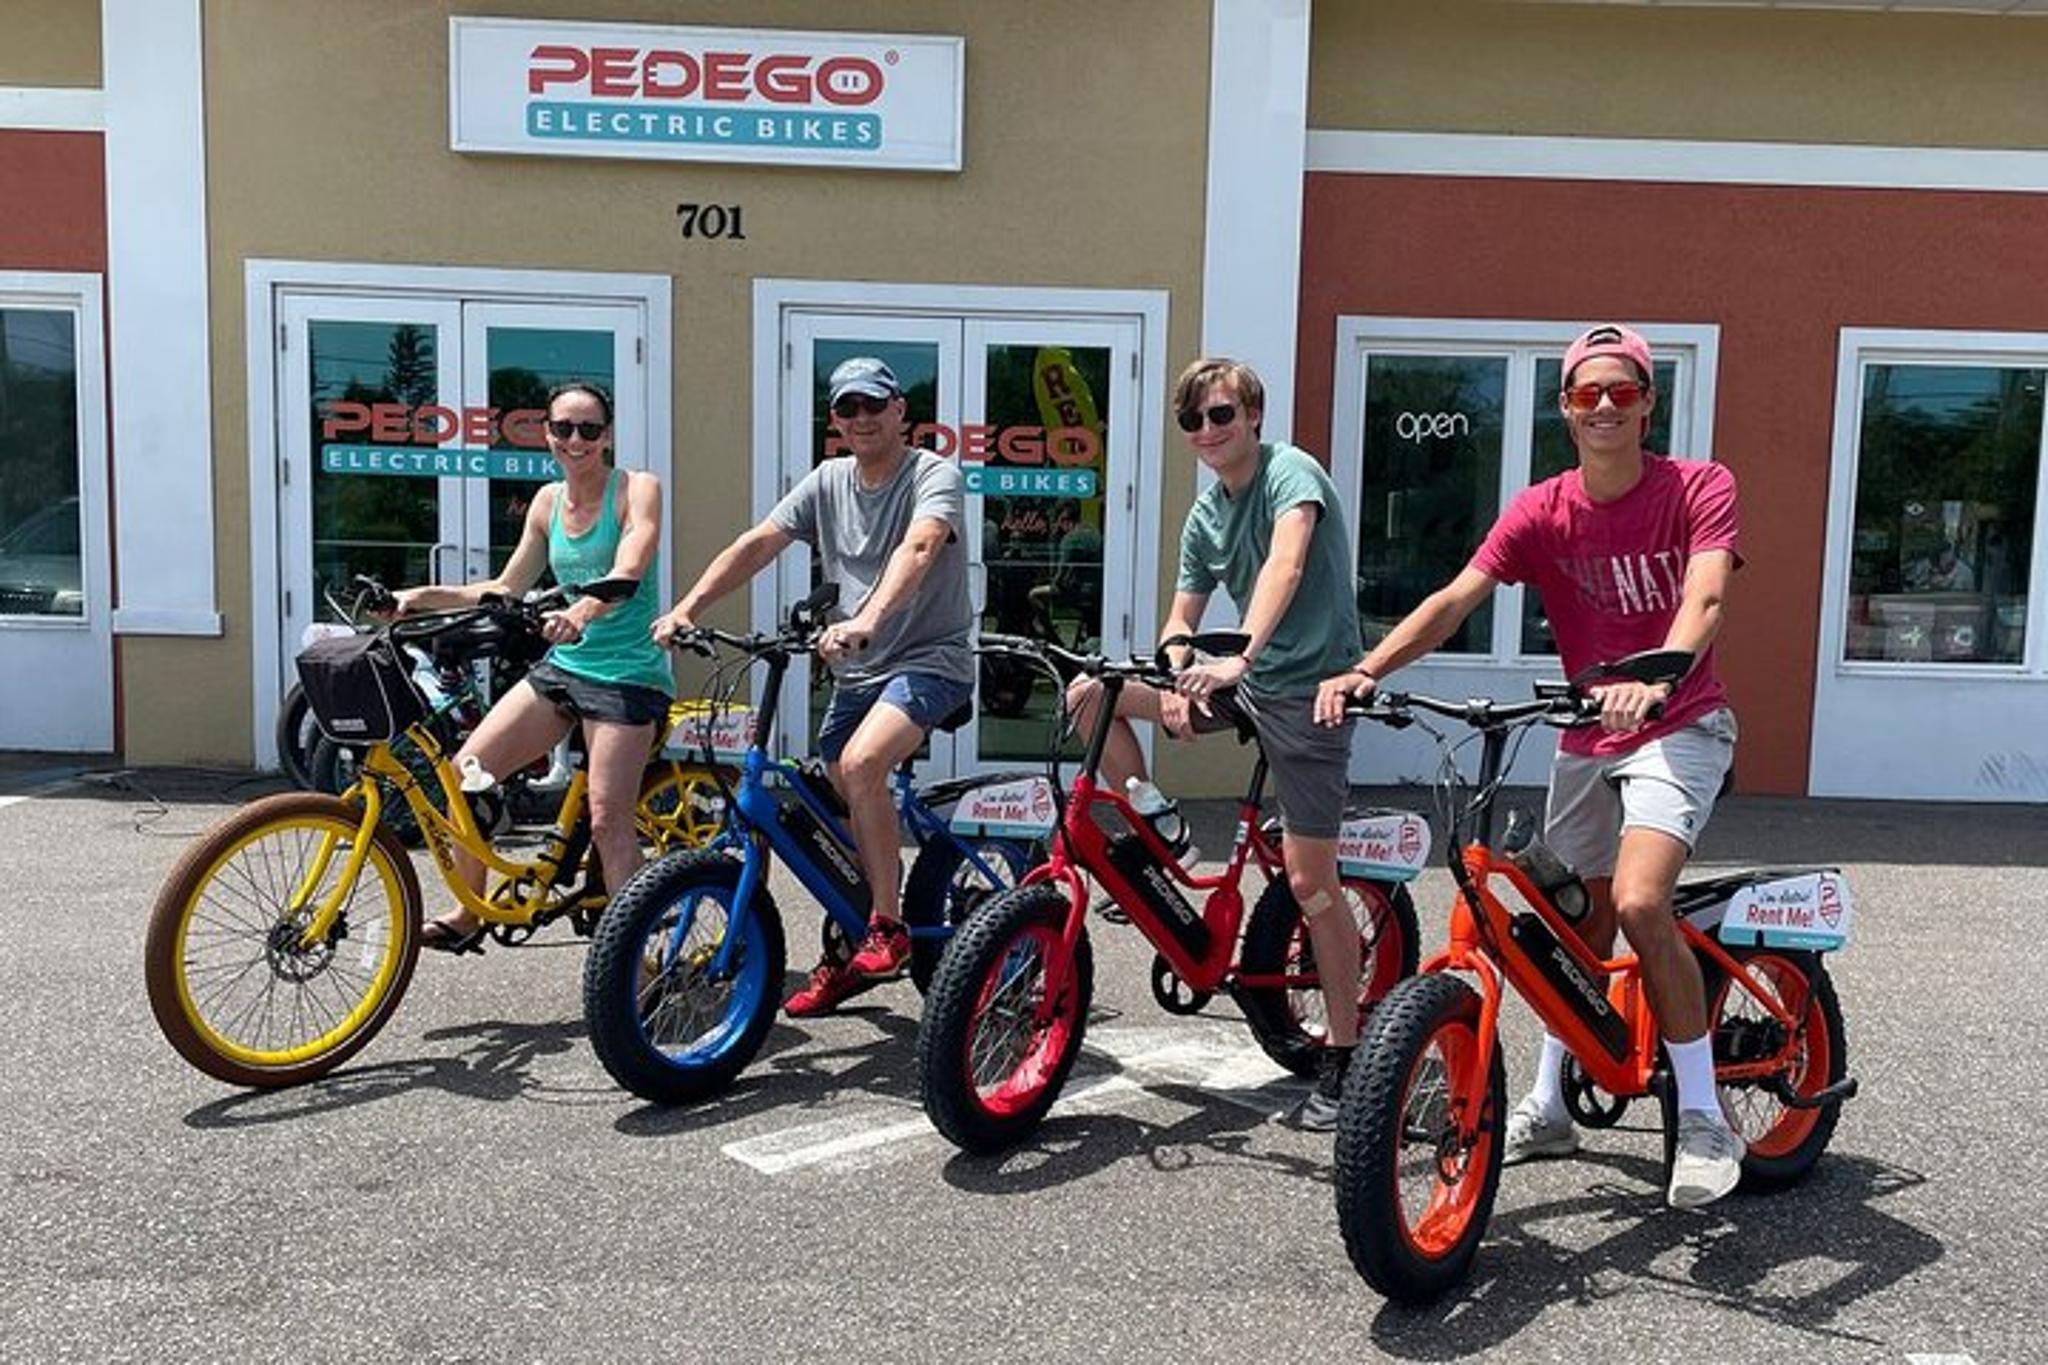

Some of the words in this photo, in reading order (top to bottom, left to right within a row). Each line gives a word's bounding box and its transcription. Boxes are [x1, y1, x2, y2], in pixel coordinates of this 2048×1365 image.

[536, 110, 732, 138] ELECTRIC
[757, 118, 872, 142] BIKES
[677, 203, 746, 240] 701
[323, 401, 547, 448] PEDEG
[1396, 411, 1468, 444] open
[328, 451, 486, 473] ELECTRIC
[505, 457, 556, 477] BIK
[999, 473, 1089, 493] BIKES
[971, 802, 1002, 819] Rent
[1004, 804, 1028, 820] Me!
[1340, 841, 1363, 857] ent
[1366, 843, 1394, 861] Me!
[1746, 903, 1783, 925] Rent
[1786, 906, 1814, 928] Me!
[1553, 946, 1609, 1016] PEDEGO
